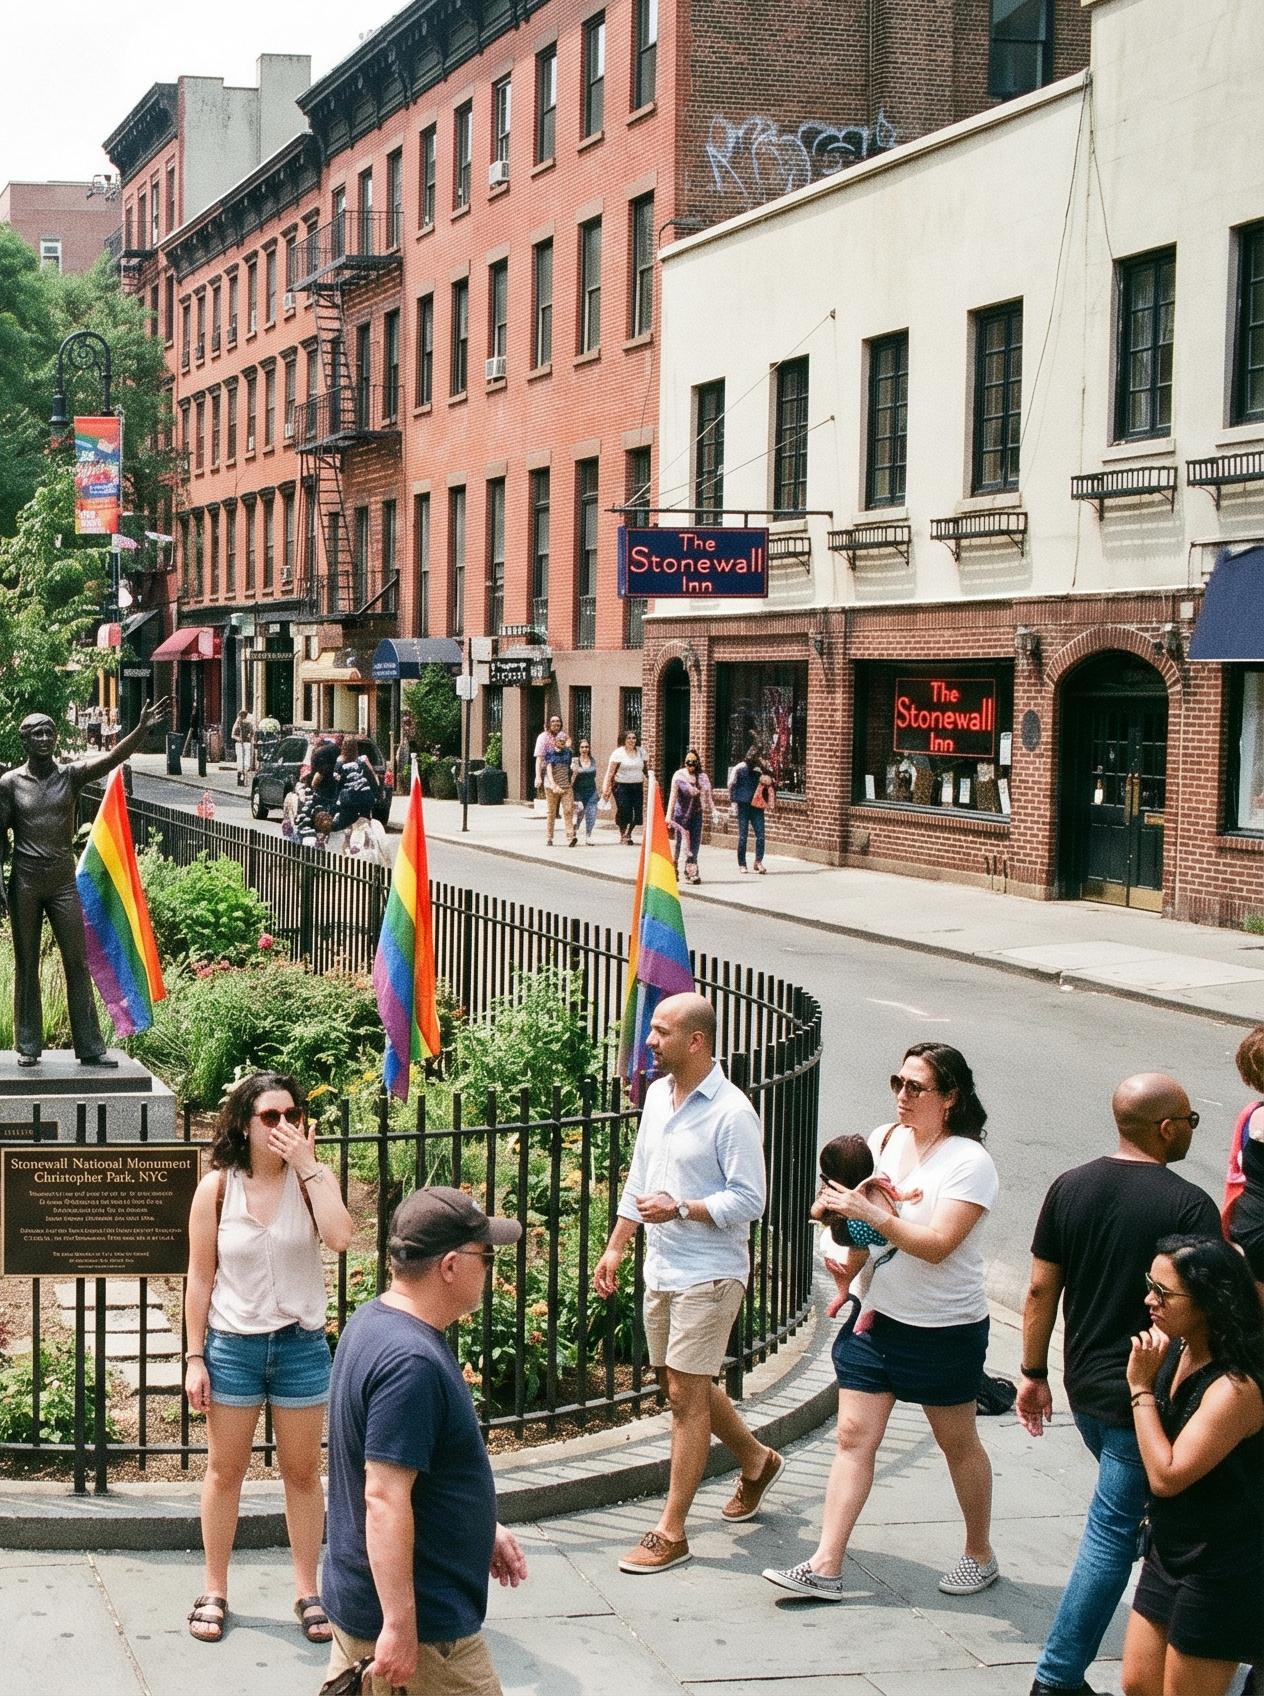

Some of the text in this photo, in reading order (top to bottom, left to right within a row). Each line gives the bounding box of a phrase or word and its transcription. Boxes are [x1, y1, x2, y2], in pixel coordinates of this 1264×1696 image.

[679, 533, 716, 552] The
[630, 546, 763, 574] Stonewall
[682, 576, 713, 593] Inn
[930, 681, 960, 703] The
[897, 696, 993, 731] Stonewall
[929, 732, 955, 752] Inn
[11, 1157, 191, 1169] Stonewall National Monument
[34, 1171, 103, 1186] Christopher
[139, 1171, 168, 1183] NYC
